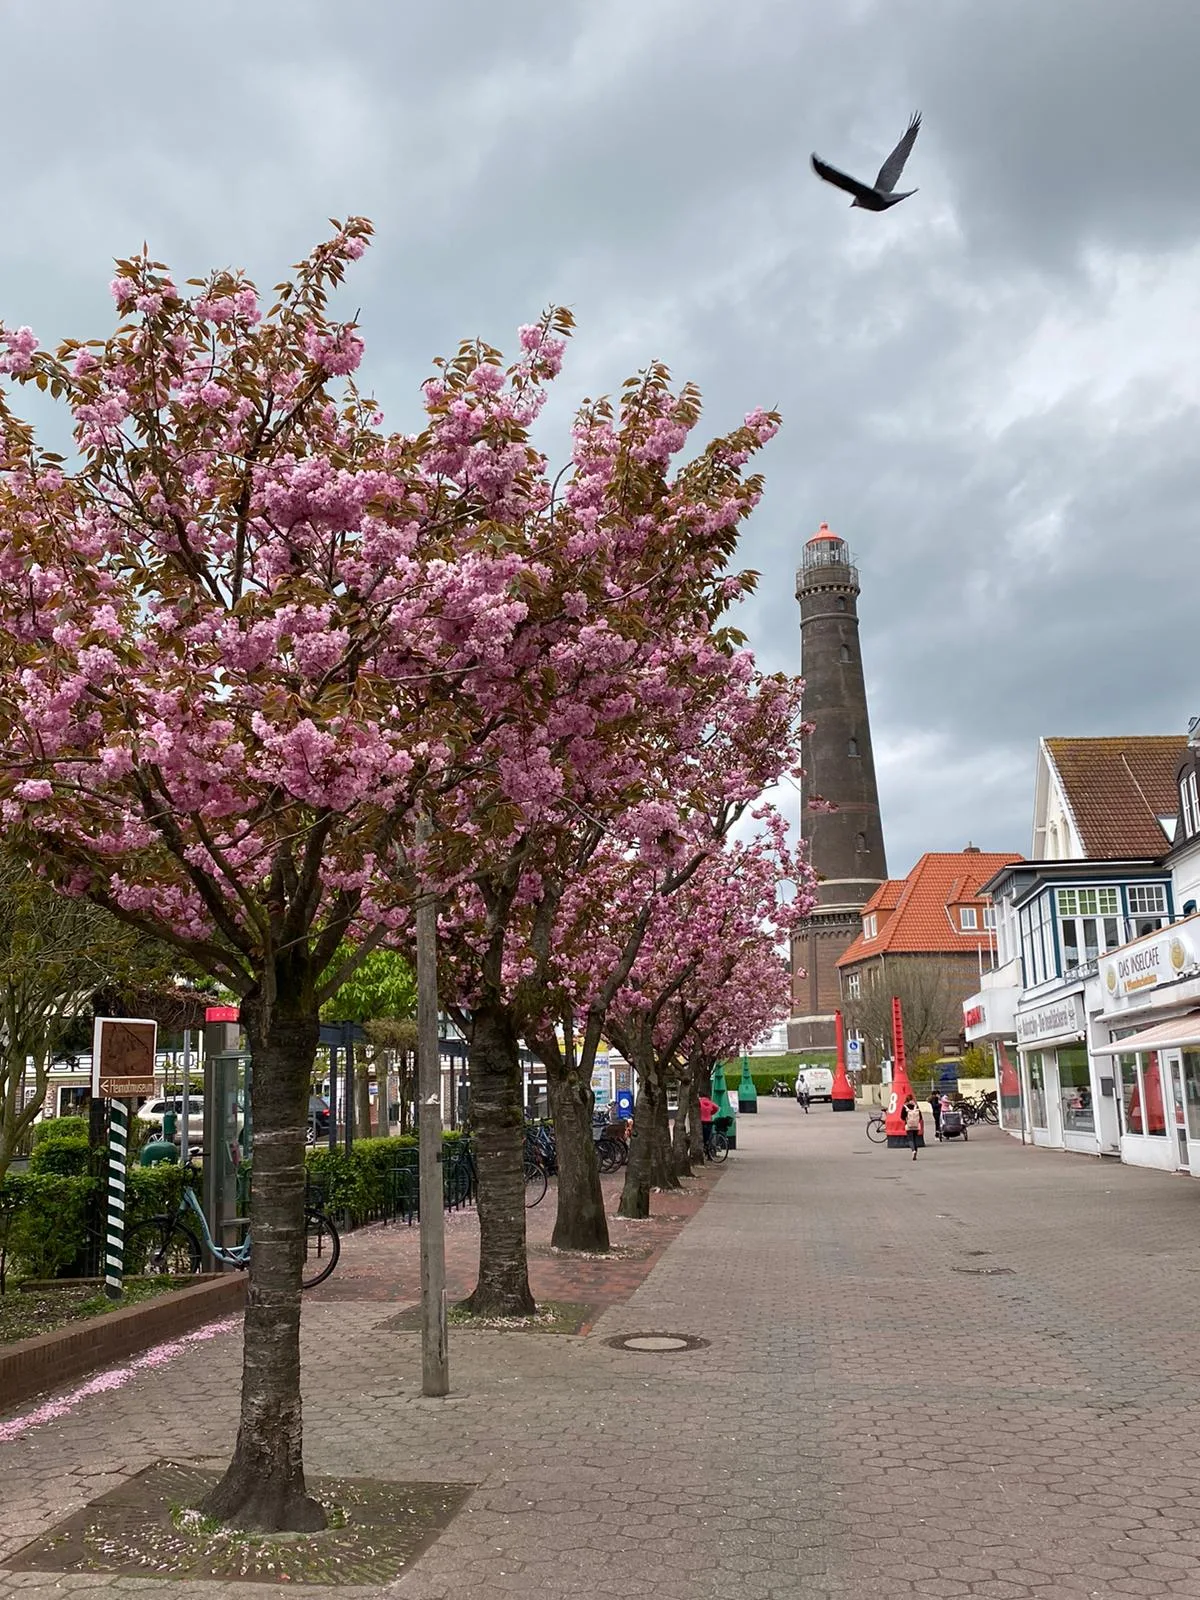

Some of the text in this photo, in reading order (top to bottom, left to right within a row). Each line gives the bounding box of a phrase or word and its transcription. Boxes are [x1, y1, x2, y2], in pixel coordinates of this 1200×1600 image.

[1118, 958, 1130, 979] DAS
[110, 1079, 154, 1094] Heimatmuseum
[888, 1092, 898, 1114] 8
